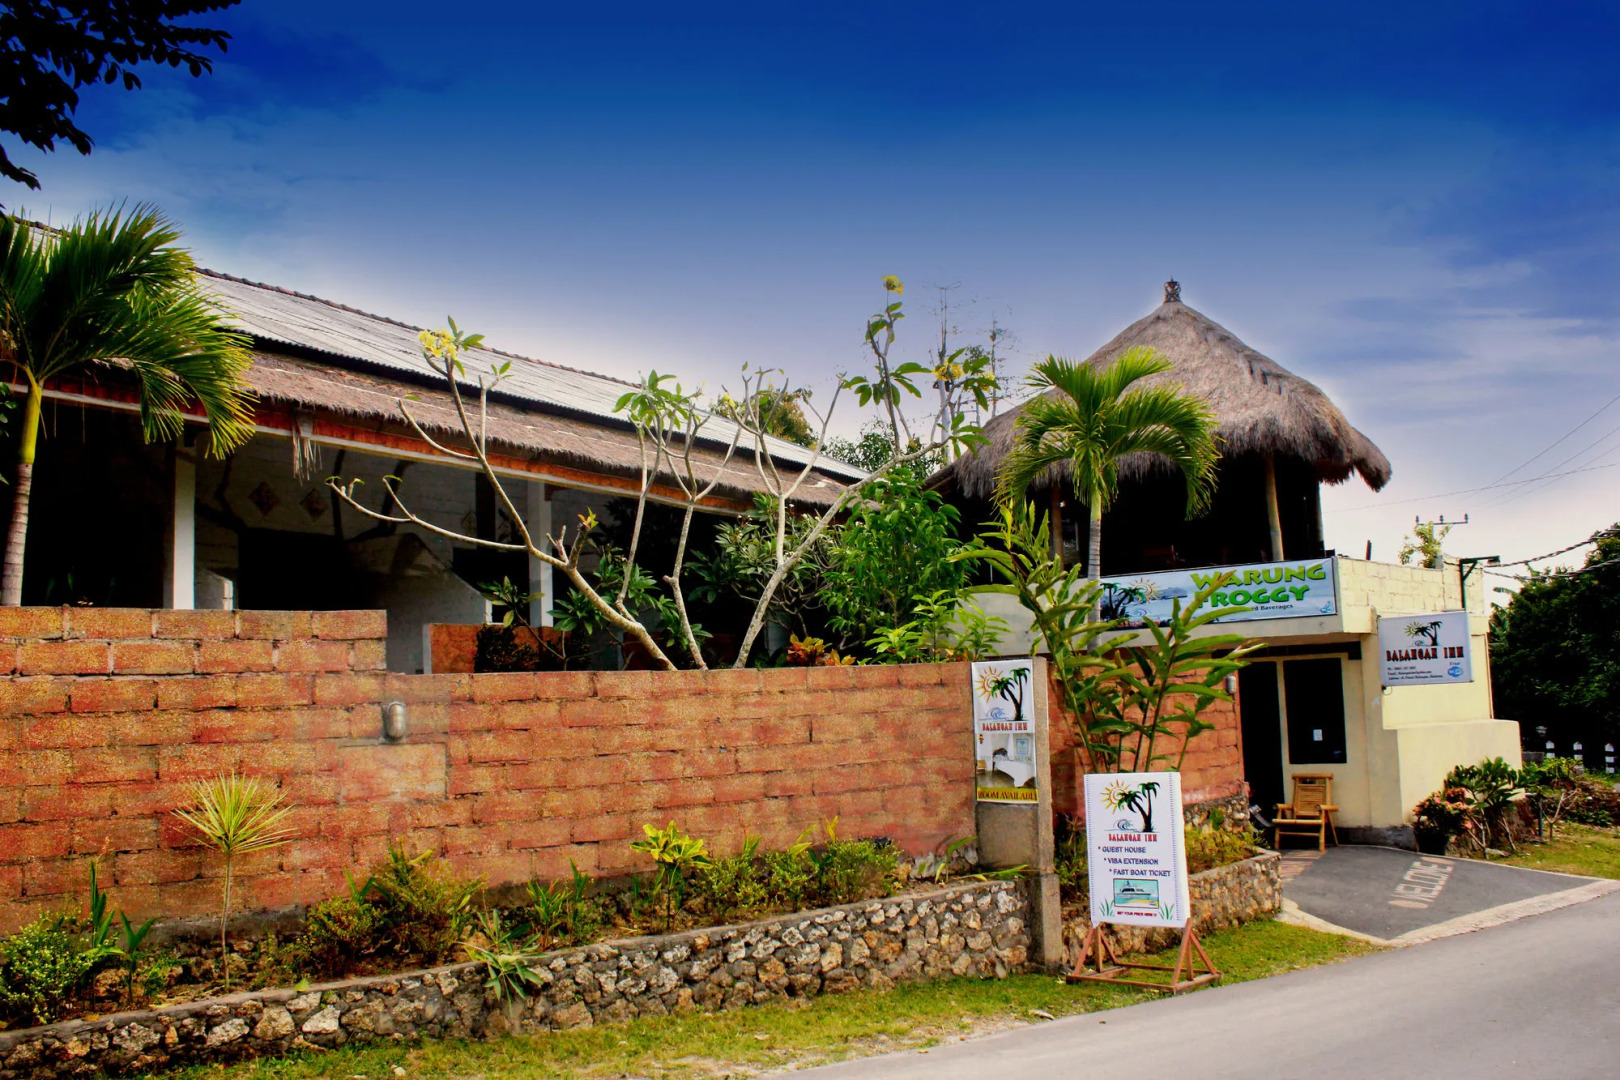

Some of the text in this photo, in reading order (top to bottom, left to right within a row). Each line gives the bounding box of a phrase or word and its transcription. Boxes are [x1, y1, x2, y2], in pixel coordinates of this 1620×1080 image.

[1191, 564, 1326, 590] WARUNG
[1386, 646, 1464, 662] BALANGAN INN
[982, 722, 1028, 731] BALANGAN INN
[978, 790, 999, 799] ROOM
[1108, 834, 1158, 842] BALANGAN INN
